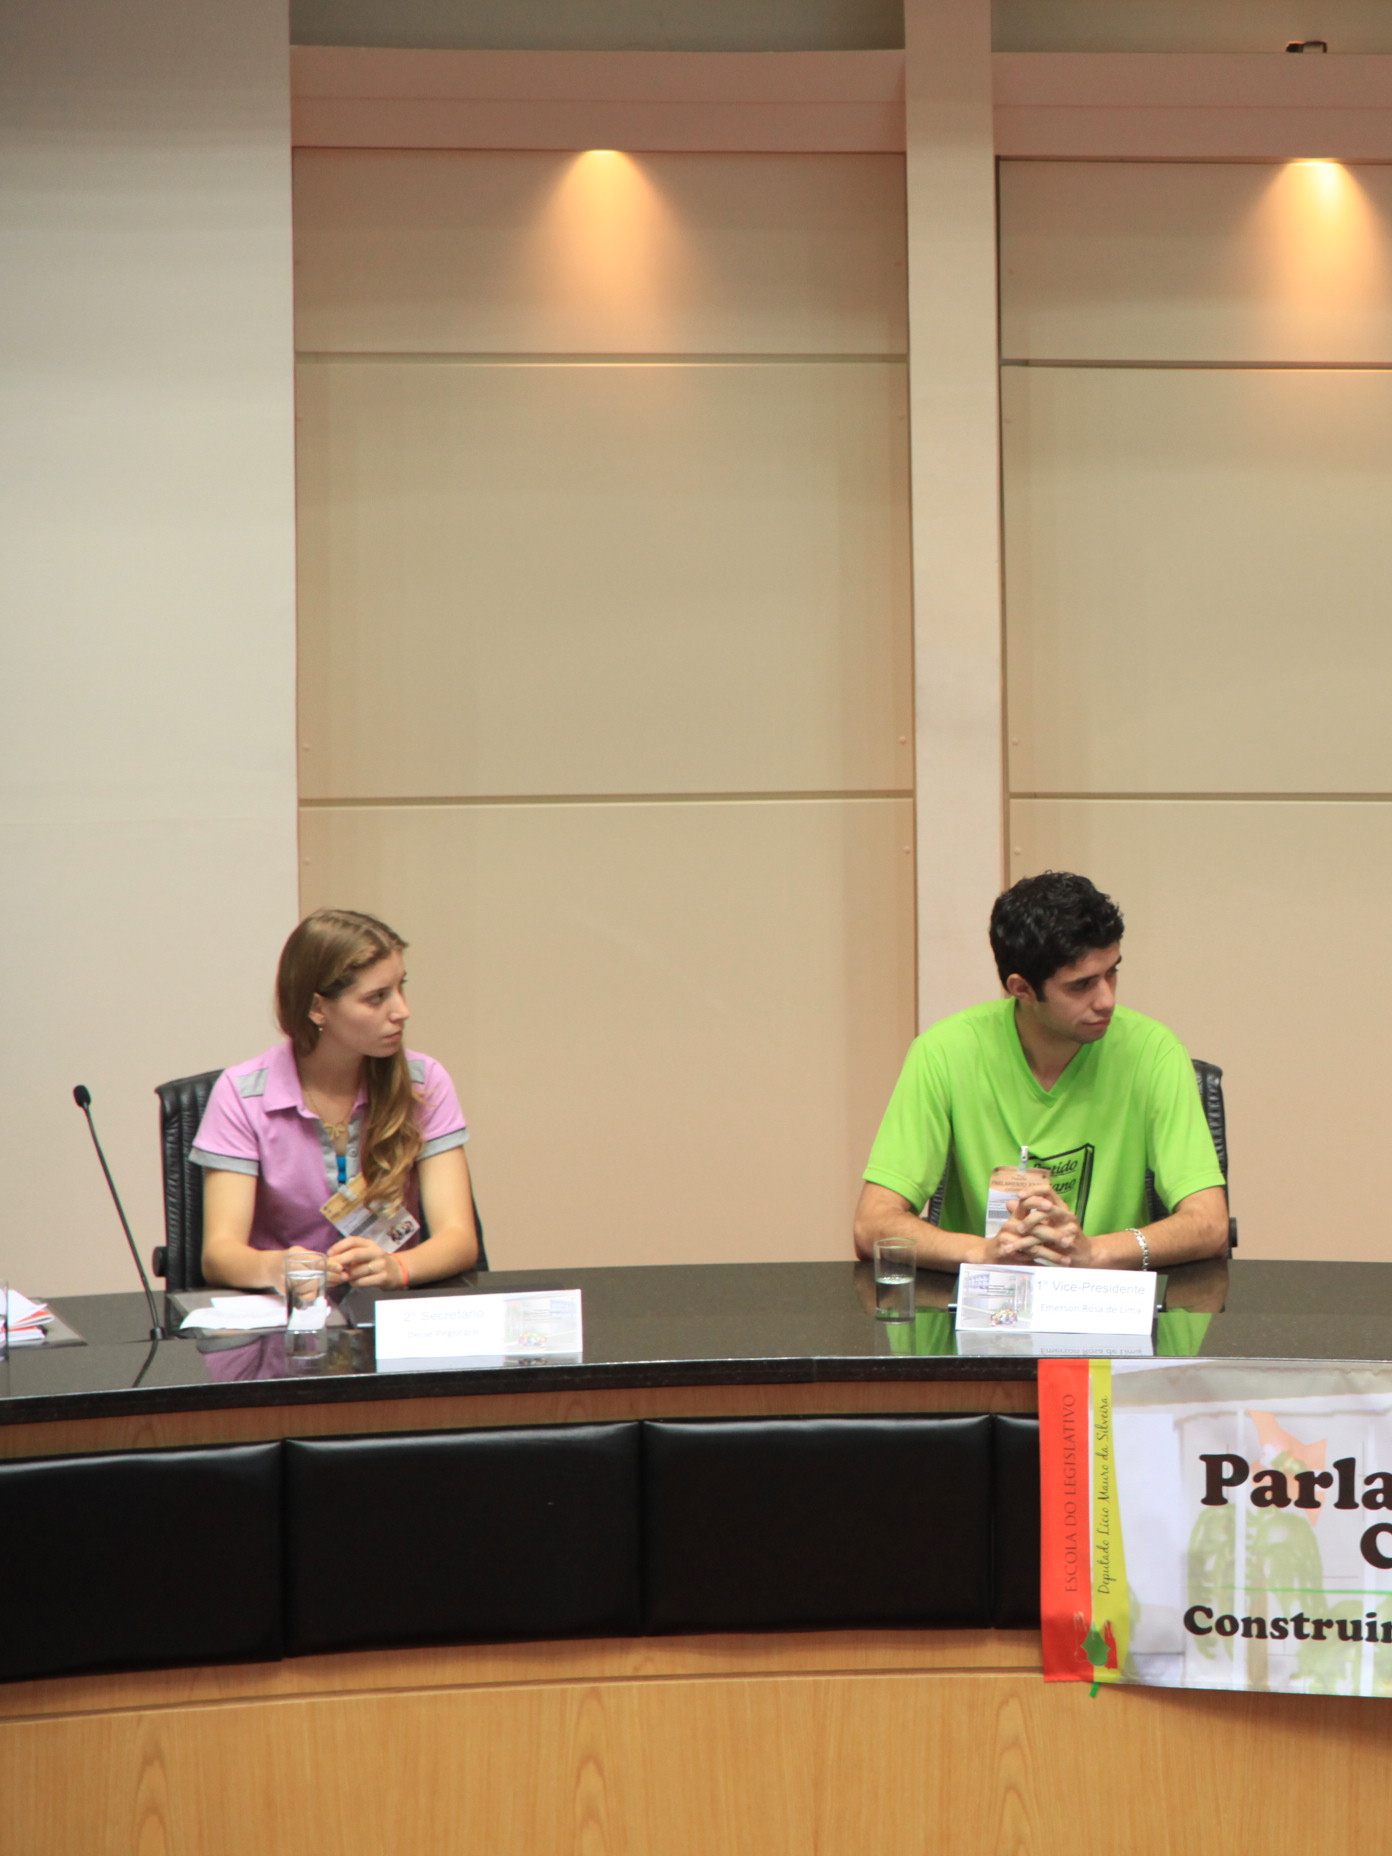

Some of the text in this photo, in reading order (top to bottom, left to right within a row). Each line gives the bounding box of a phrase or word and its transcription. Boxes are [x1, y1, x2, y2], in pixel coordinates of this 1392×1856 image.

[1034, 1160, 1078, 1175] Ptido
[1052, 1281, 1145, 1295] Vice-Presidente
[1040, 1303, 1142, 1314] Emerson Rosa de Lima
[1094, 1396, 1109, 1442] Silveira
[1095, 1446, 1109, 1460] da
[1062, 1394, 1078, 1592] ESCOLA DO LEGISLATIVO
[1097, 1464, 1110, 1503] Mauro
[1096, 1540, 1117, 1594] Deputado
